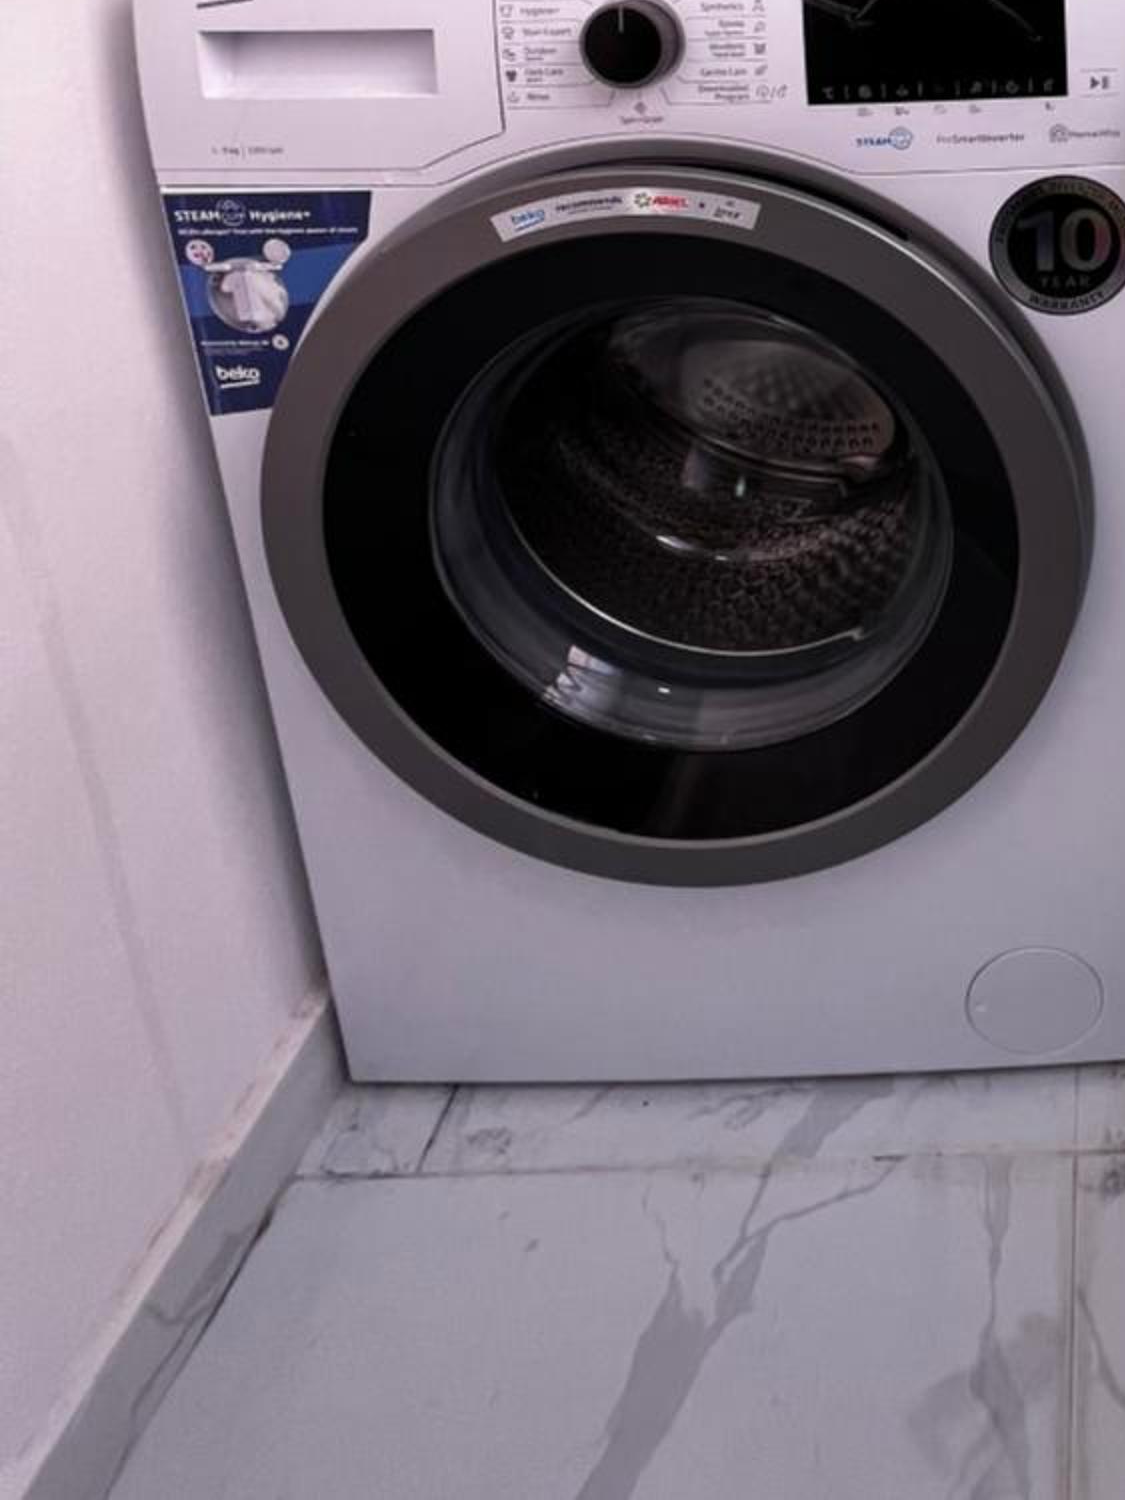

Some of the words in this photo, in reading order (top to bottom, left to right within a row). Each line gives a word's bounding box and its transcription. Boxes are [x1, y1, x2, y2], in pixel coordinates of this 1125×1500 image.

[173, 210, 221, 223] STEAM
[1015, 208, 1112, 273] 10
[215, 364, 260, 384] beko
